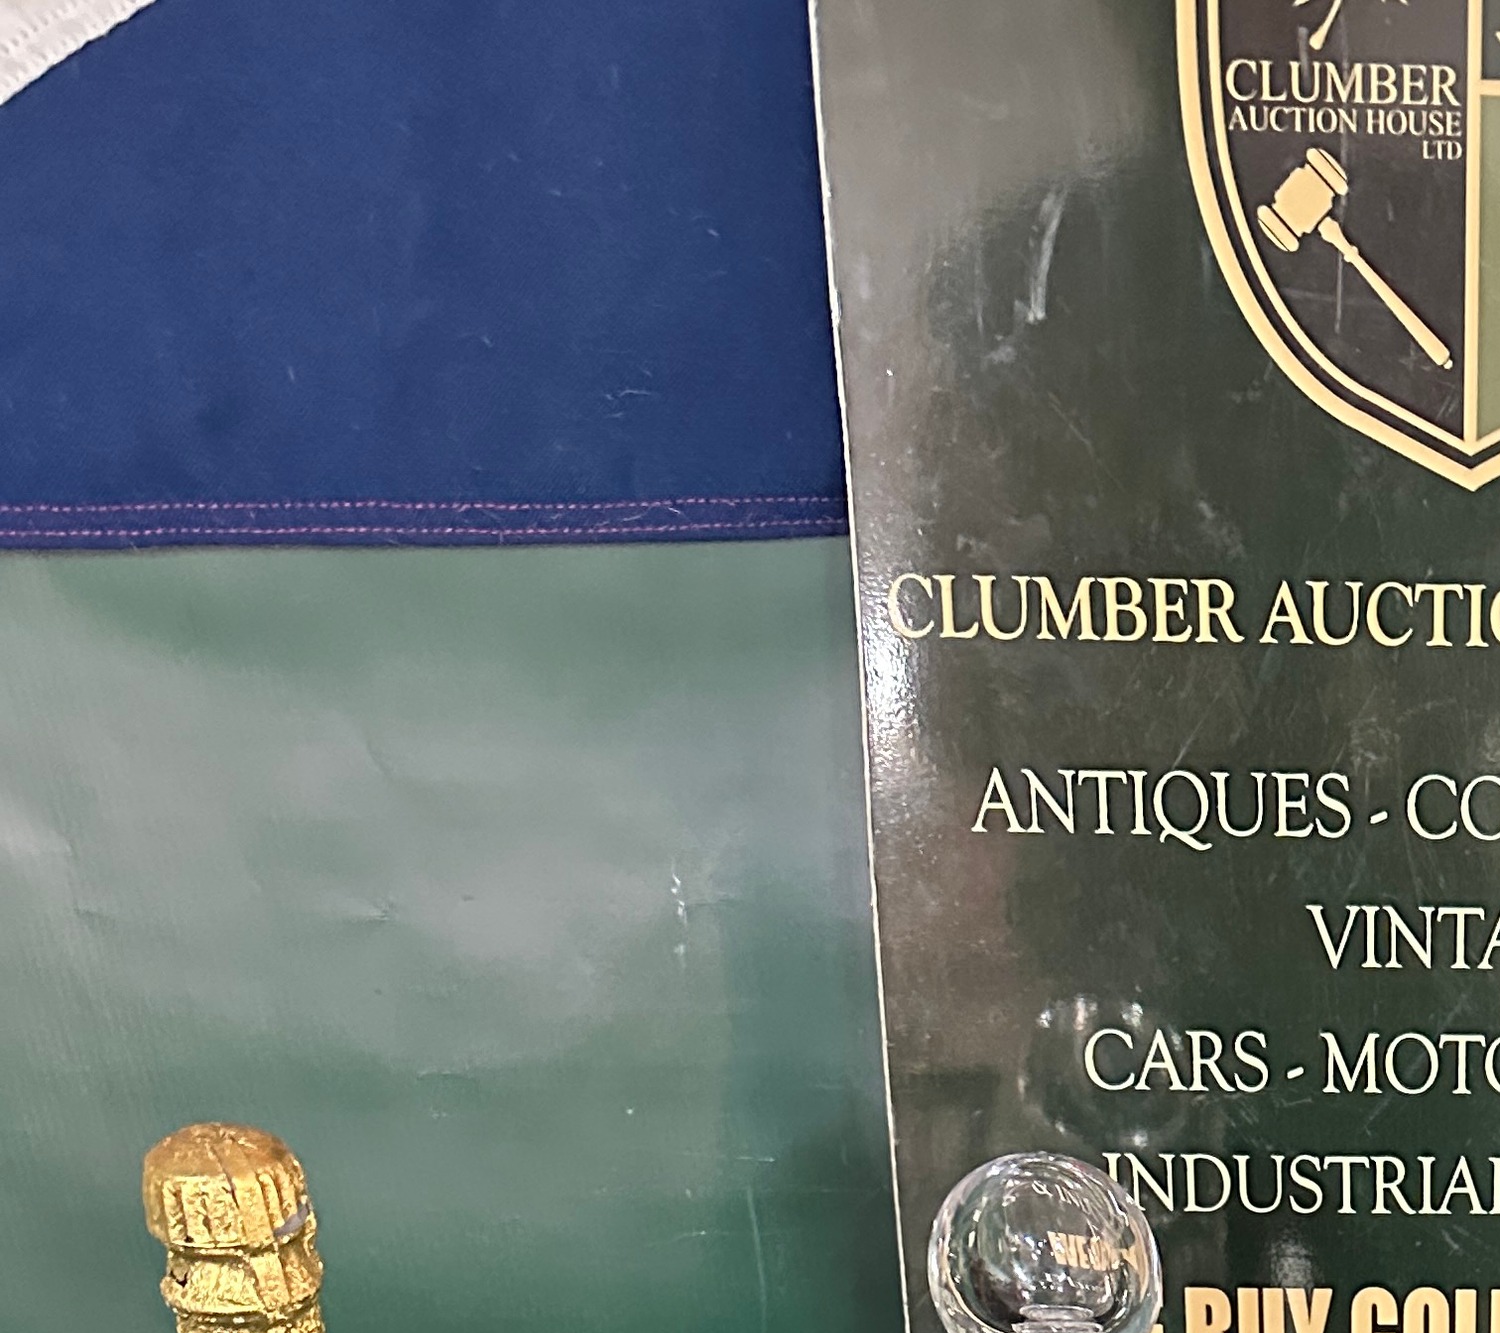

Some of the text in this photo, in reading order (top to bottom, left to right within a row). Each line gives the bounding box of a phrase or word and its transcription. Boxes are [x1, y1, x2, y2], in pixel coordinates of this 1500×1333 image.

[1226, 60, 1460, 107] CLUMBER
[1229, 106, 1462, 137] AUCTION HOUSE
[1422, 141, 1463, 160] LTD
[888, 573, 1245, 644] CLUMBER
[972, 767, 1352, 851] ANTIQUES
[1084, 1029, 1270, 1092] CARS
